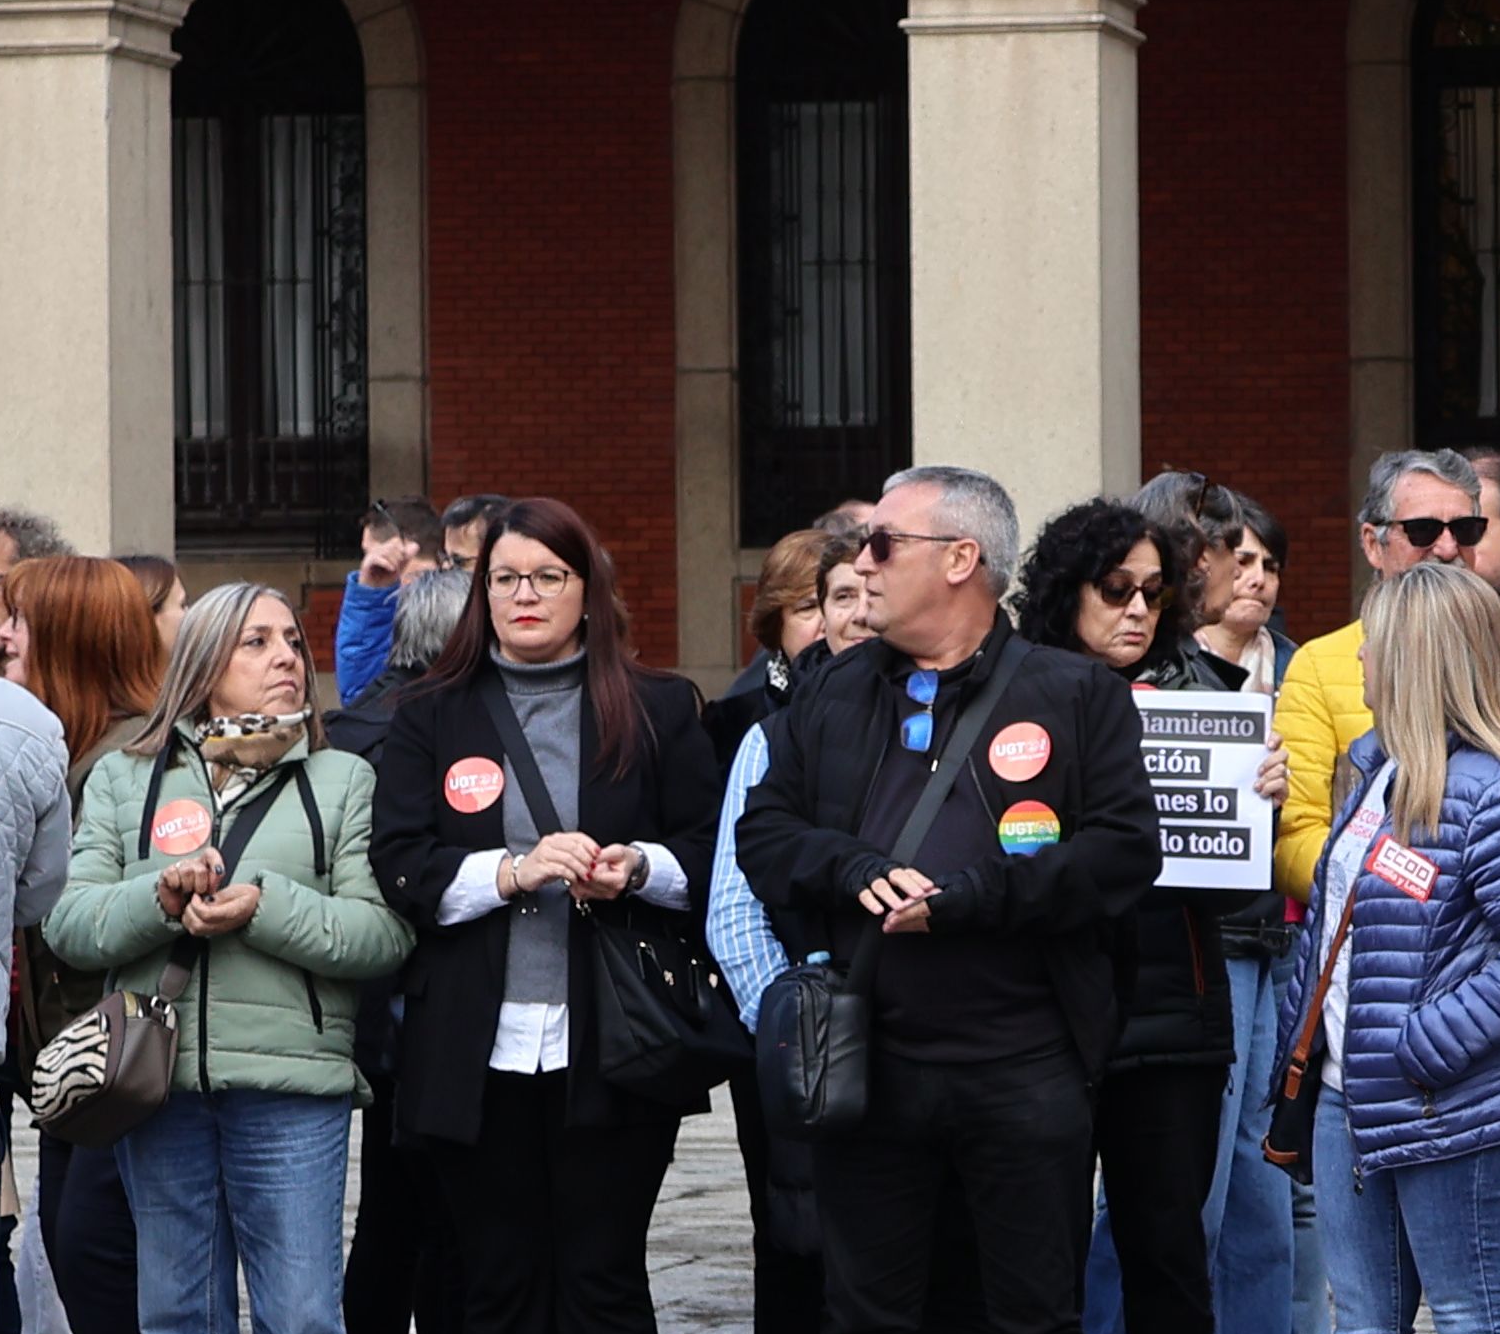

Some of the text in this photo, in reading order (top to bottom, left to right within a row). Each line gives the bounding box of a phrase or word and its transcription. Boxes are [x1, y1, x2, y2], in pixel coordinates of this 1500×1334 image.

[1140, 712, 1255, 737] ñamiento
[995, 742, 1025, 758] UGT
[1203, 790, 1229, 813] lo
[1005, 822, 1035, 836] UGT
[1189, 831, 1245, 856] todo
[1384, 846, 1430, 882] CCOO
[1404, 880, 1426, 899] León
